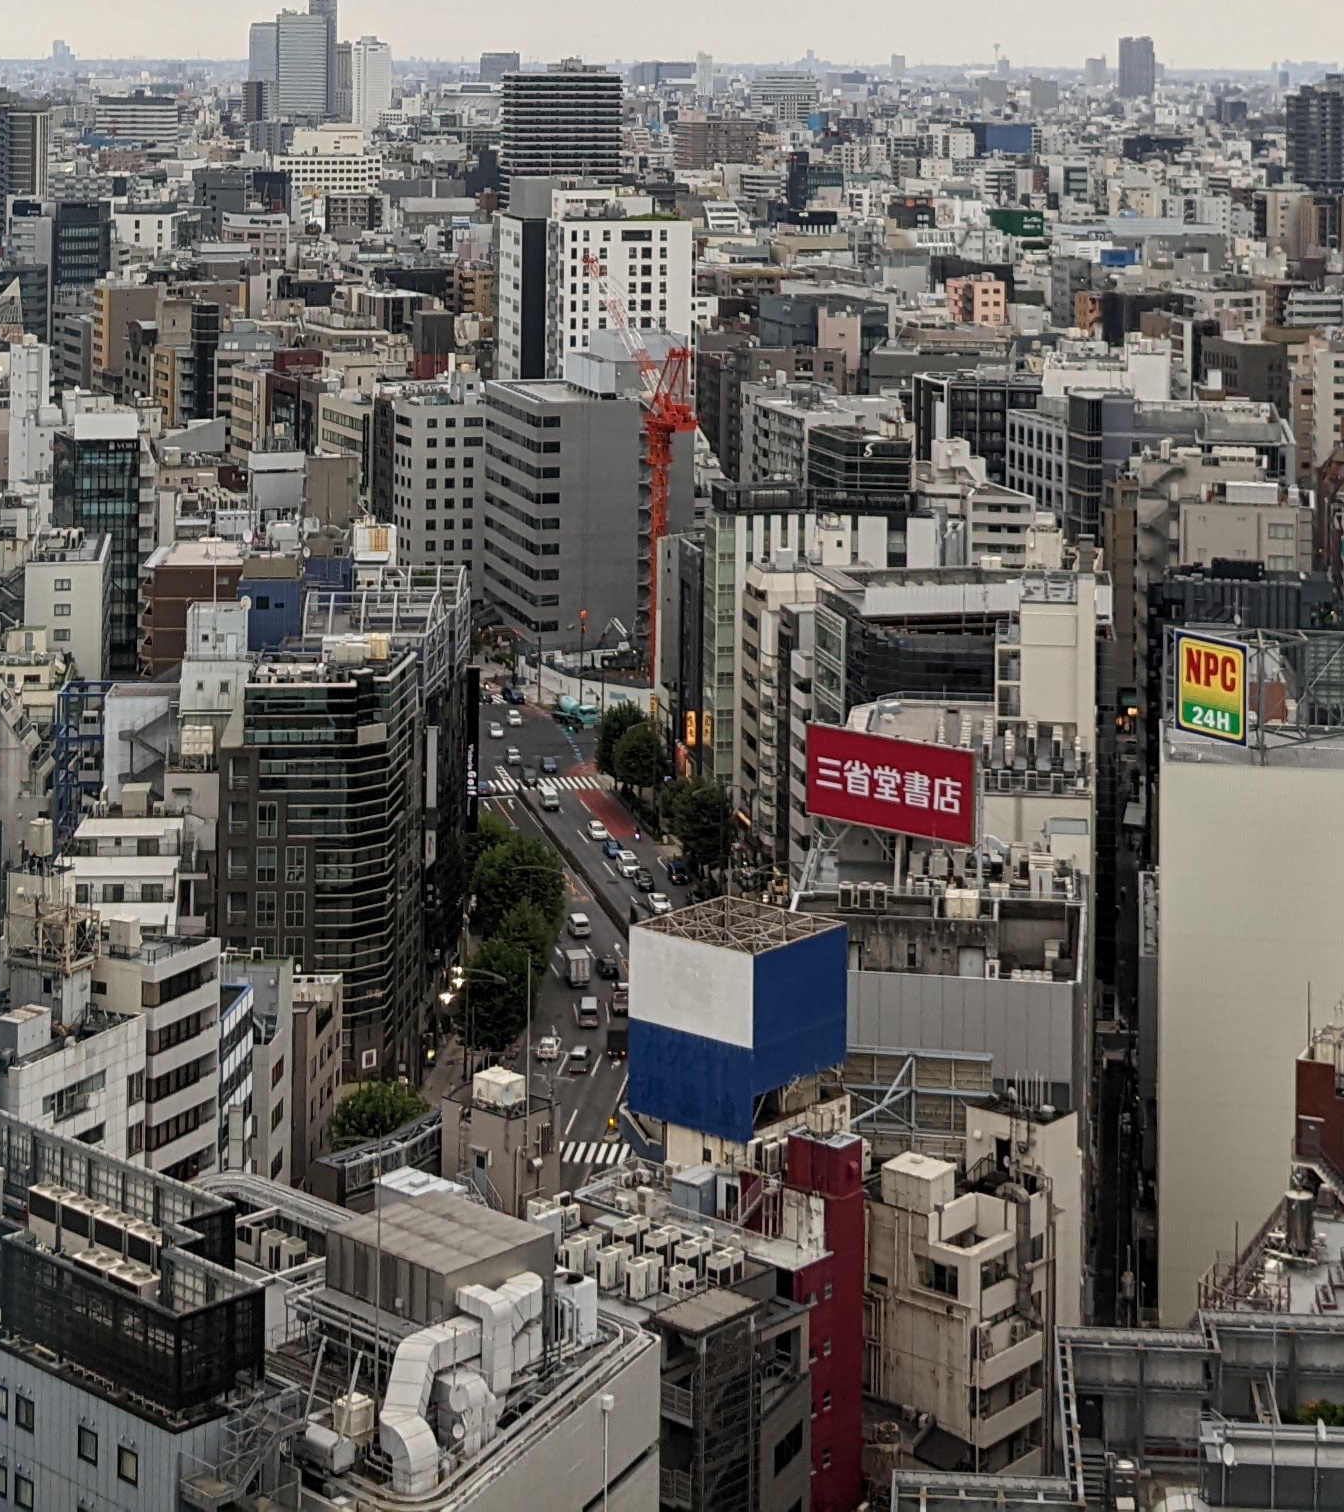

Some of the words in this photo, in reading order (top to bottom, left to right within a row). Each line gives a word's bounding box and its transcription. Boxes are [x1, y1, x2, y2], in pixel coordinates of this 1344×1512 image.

[1185, 647, 1237, 693] NPC
[1191, 705, 1231, 732] 24H
[467, 770, 477, 796] Golf
[815, 755, 963, 816] 三省堂書店
